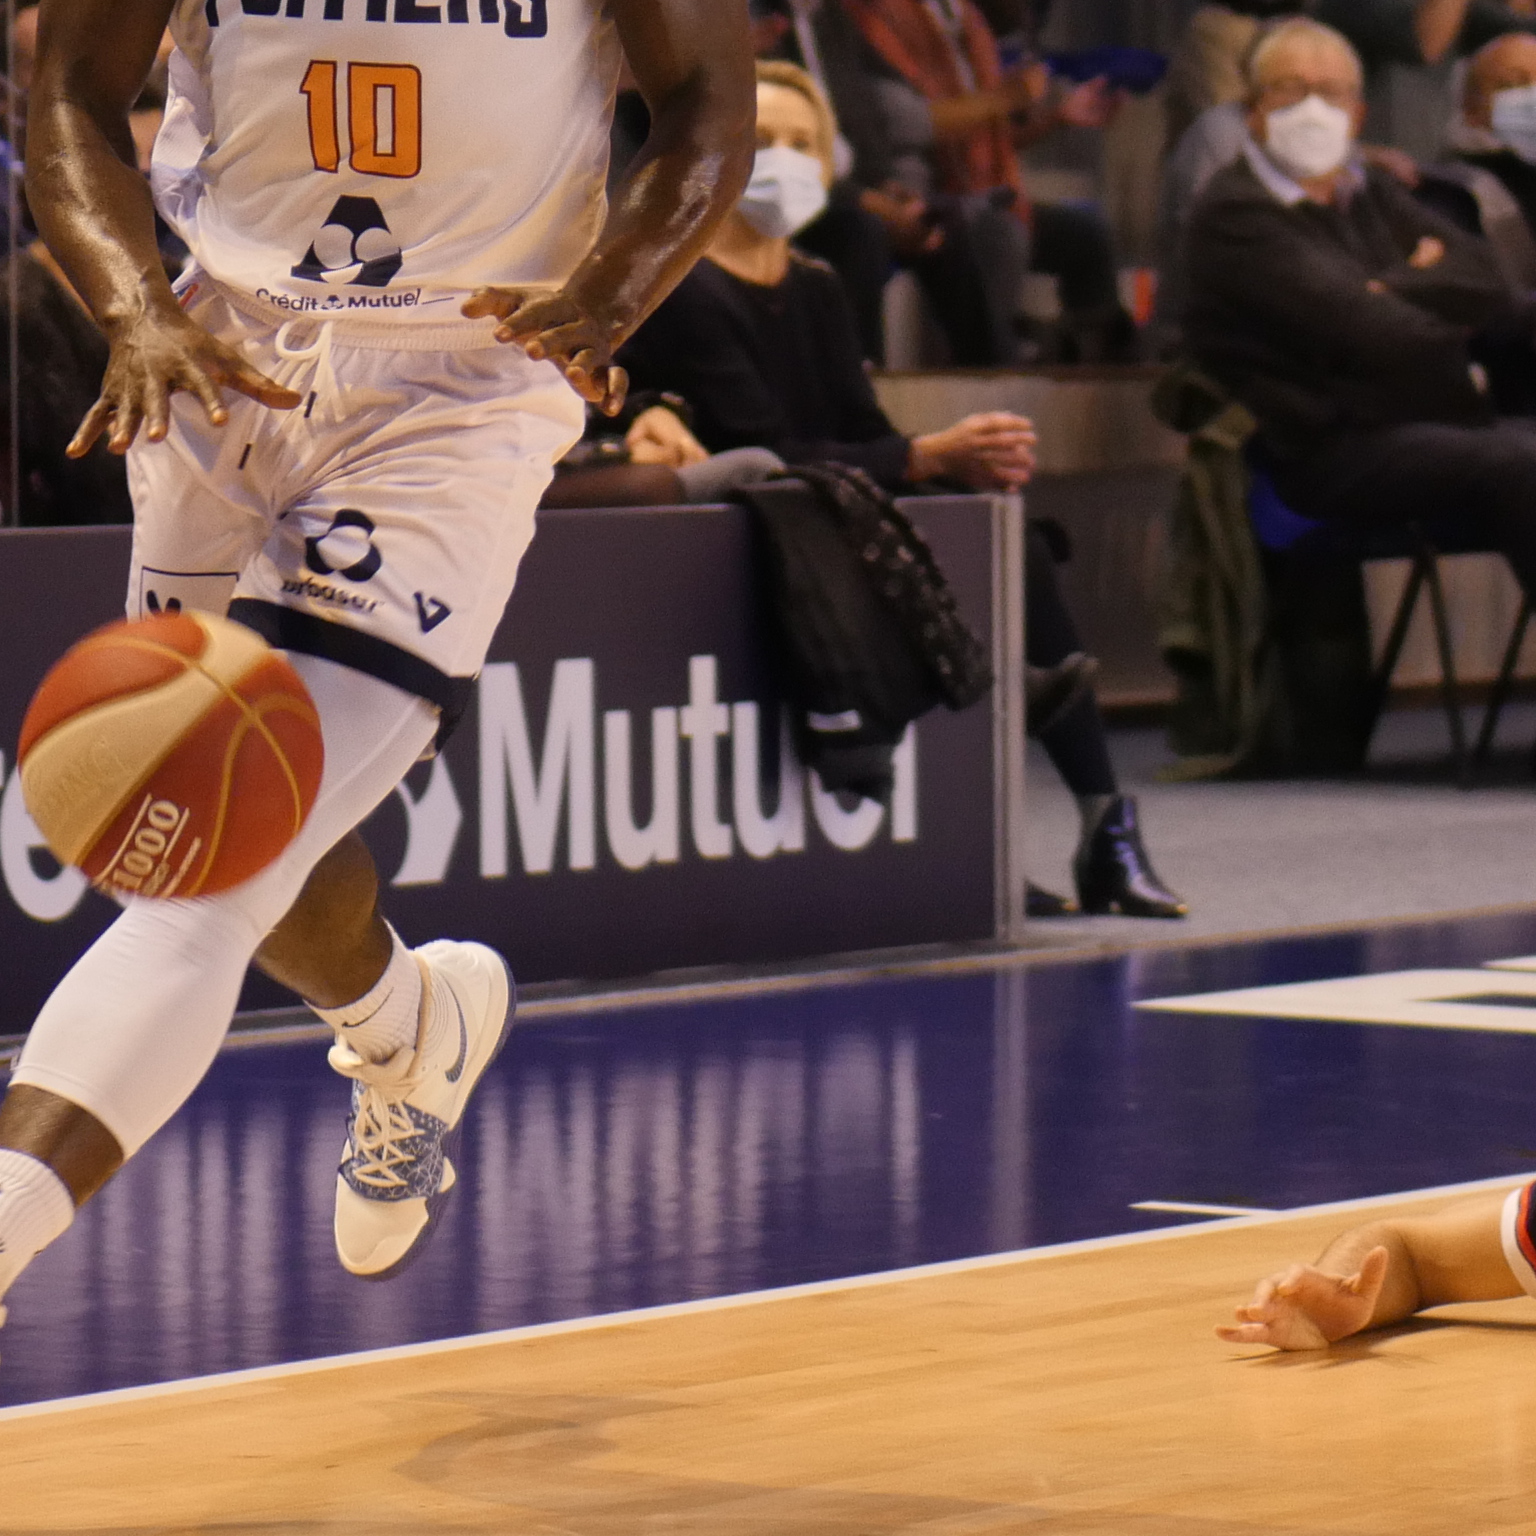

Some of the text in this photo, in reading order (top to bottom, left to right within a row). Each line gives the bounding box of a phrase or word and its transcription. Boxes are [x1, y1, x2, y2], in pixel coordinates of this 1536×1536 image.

[299, 59, 422, 179] 10
[256, 288, 421, 311] Crédit Mutuel
